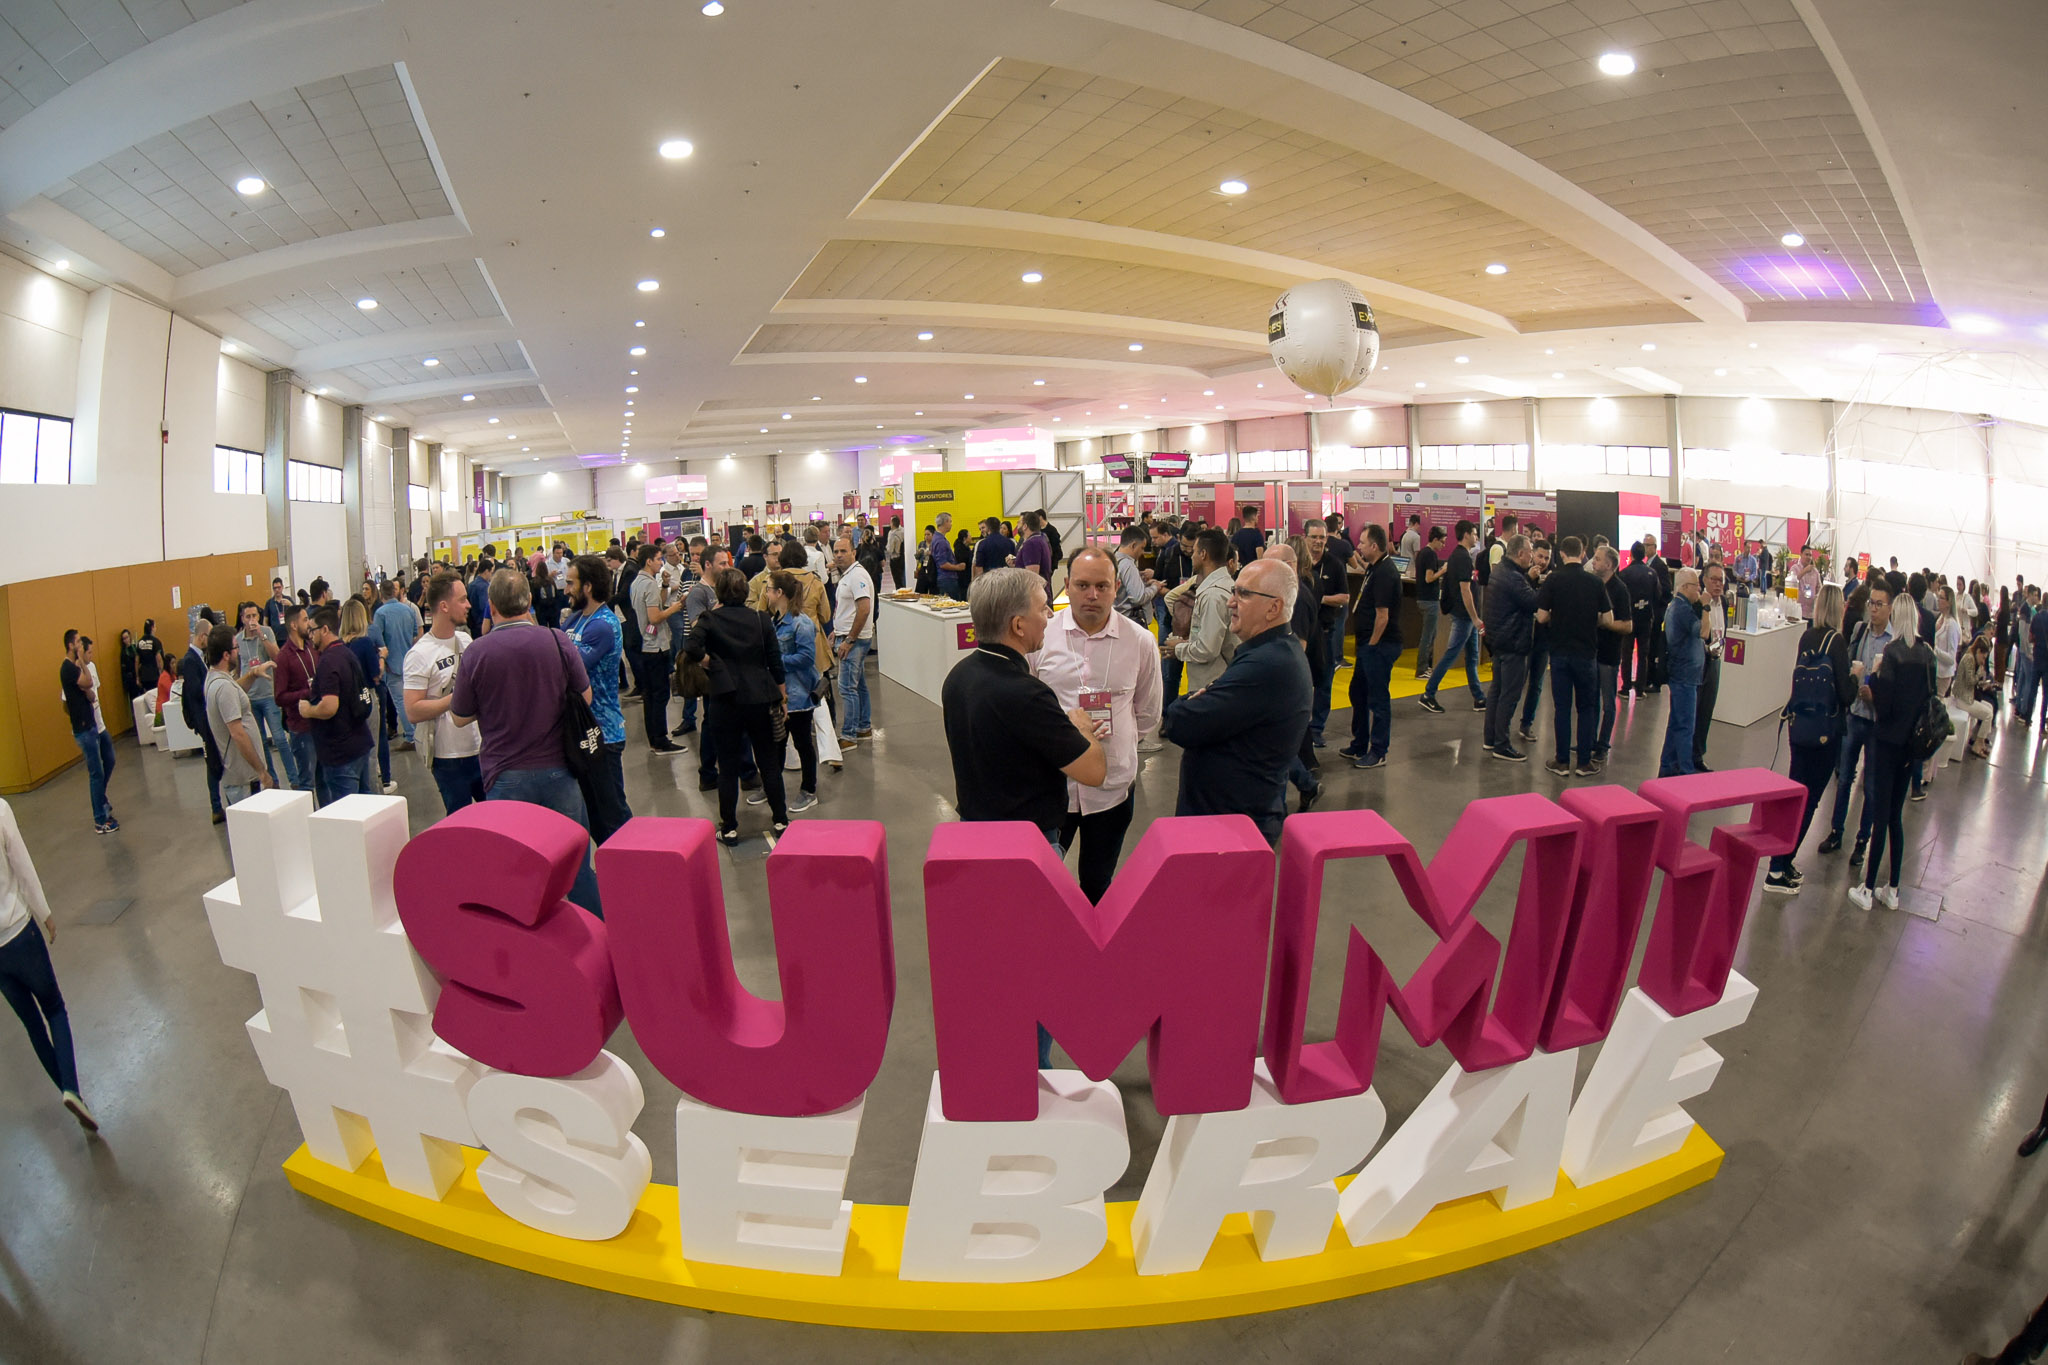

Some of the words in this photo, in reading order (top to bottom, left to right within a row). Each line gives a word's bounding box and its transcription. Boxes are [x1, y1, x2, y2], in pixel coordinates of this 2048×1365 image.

[1707, 512, 1728, 528] SU
[965, 629, 975, 643] 3
[1731, 644, 1738, 659] 1
[467, 967, 1759, 1283] SEBRAE
